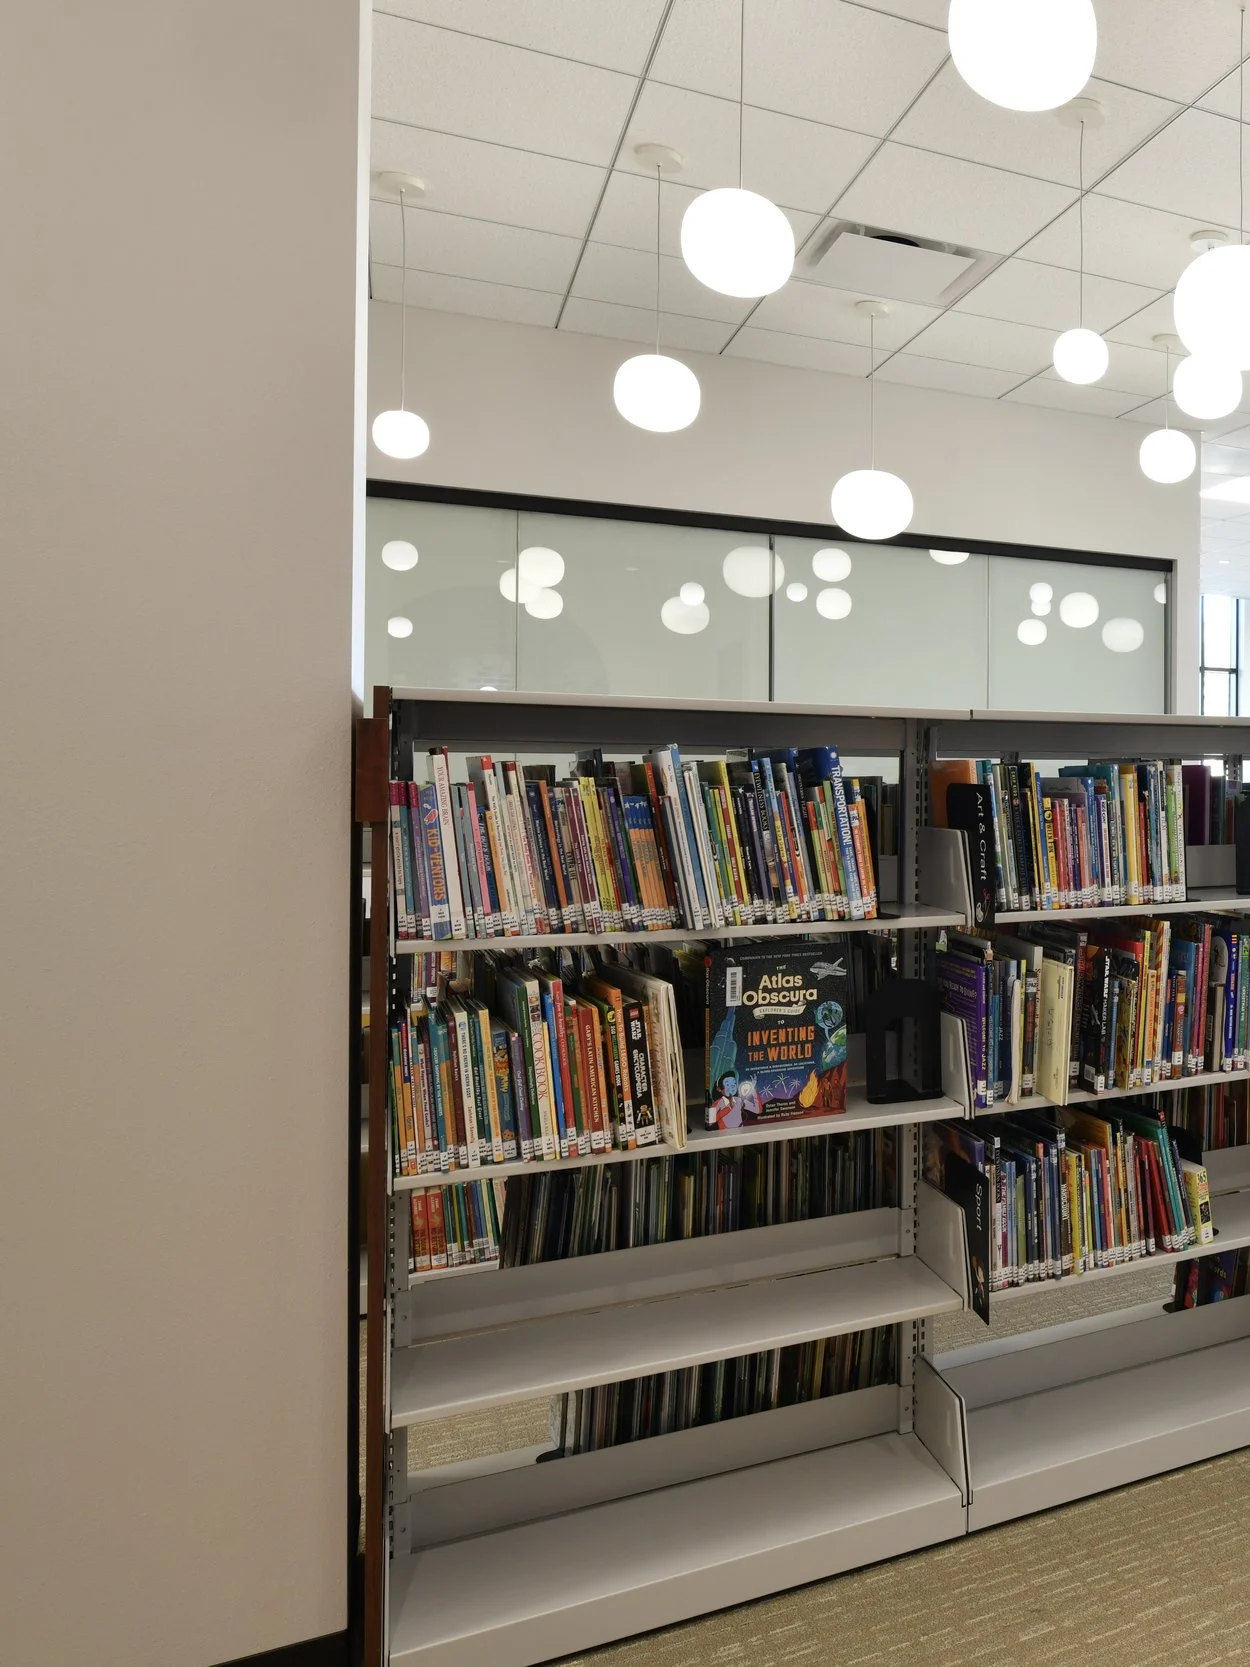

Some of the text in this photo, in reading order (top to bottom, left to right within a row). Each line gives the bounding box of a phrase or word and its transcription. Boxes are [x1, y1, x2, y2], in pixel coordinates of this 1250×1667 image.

[437, 766, 450, 826] YOUR AMAZING BRAIN
[754, 772, 769, 831] EYEWITNESS BOOKS
[831, 766, 851, 845] TRANSPORTATION!
[976, 792, 987, 881] Art & Craft
[427, 828, 446, 901] KID-VENTORS
[569, 870, 577, 881] LIFE
[759, 972, 803, 990] Atlas
[554, 1002, 563, 1013] fun
[742, 988, 818, 1006] Obscura
[759, 1006, 787, 1014] EXPLORER'S
[557, 1018, 565, 1039] healthy
[617, 1024, 624, 1032] To
[629, 1020, 637, 1041] WARS
[634, 1019, 642, 1040] STAR
[747, 1025, 815, 1047] INVENTING
[618, 1032, 626, 1049] Build
[620, 1049, 628, 1068] LEGO
[748, 1043, 814, 1062] THE WORLD
[584, 1024, 600, 1123] GABY'S LATIN AMERICAN KITCHEN
[622, 1069, 630, 1092] Robots
[631, 1048, 642, 1099] ENCYCLOPEDIA
[638, 1052, 648, 1092] CHARACTER
[1197, 1170, 1207, 1185] 365
[975, 1183, 984, 1232] Sport
